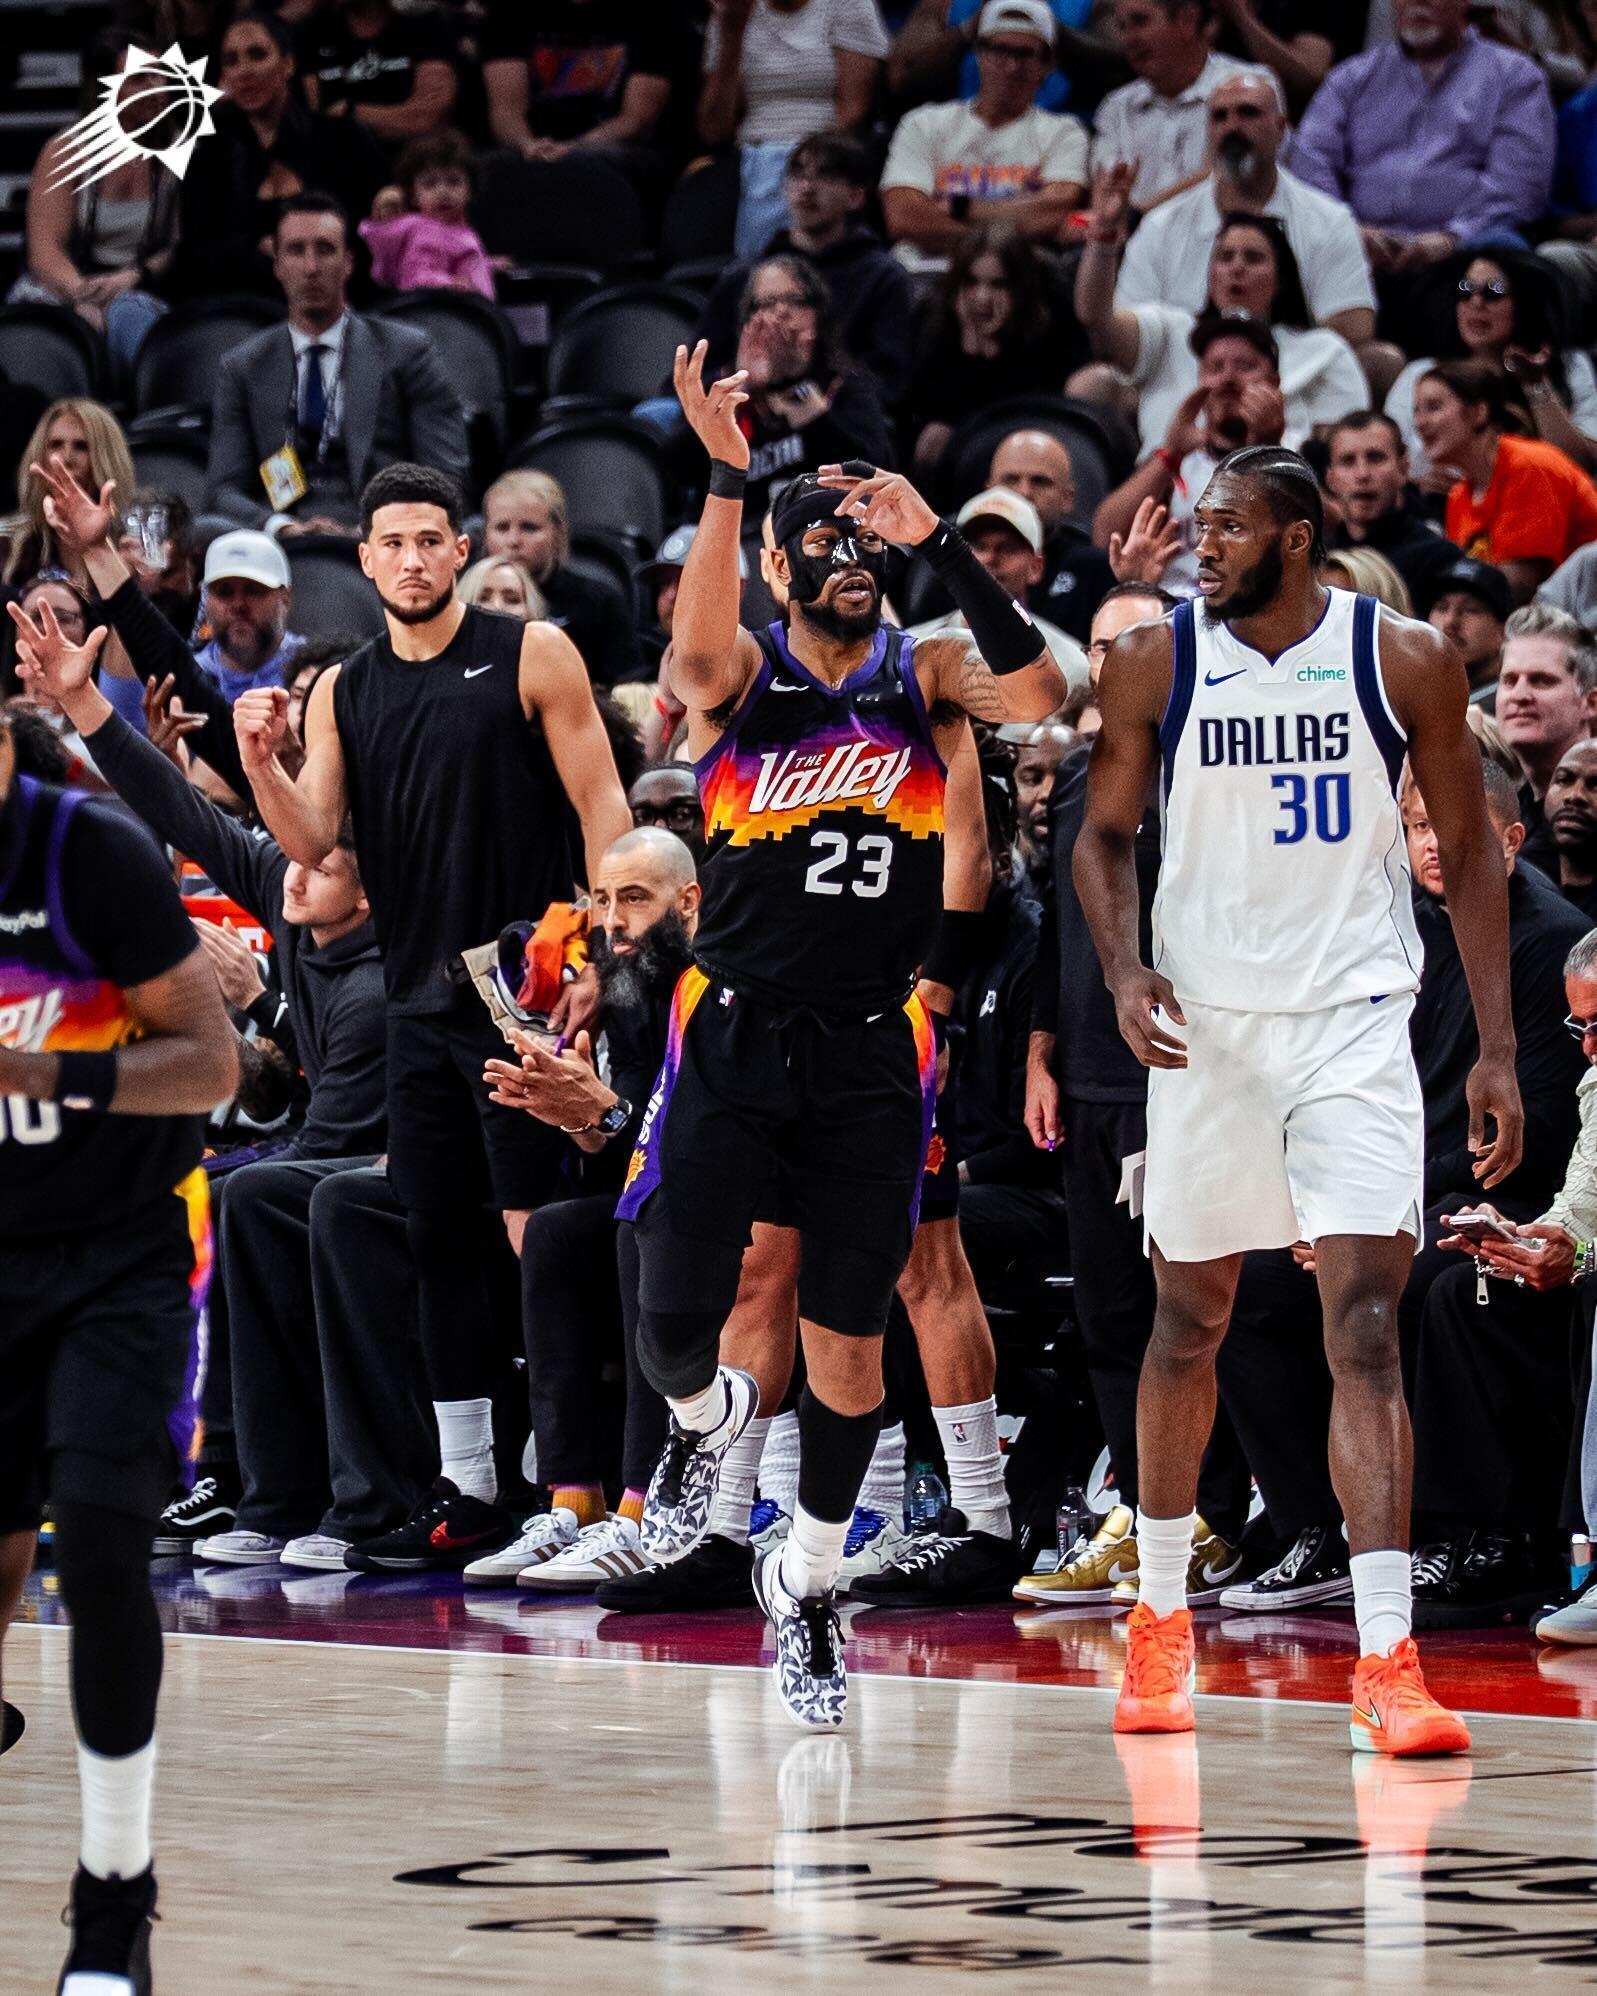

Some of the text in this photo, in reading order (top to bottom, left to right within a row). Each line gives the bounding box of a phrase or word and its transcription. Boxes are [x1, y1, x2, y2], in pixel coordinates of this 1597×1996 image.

[1296, 665, 1347, 682] chime
[795, 753, 826, 768] THE
[1199, 711, 1350, 769] DALLAS
[748, 740, 912, 814] Valley
[1270, 771, 1352, 846] 30
[804, 831, 894, 899] 23
[0, 911, 47, 934] ayPal
